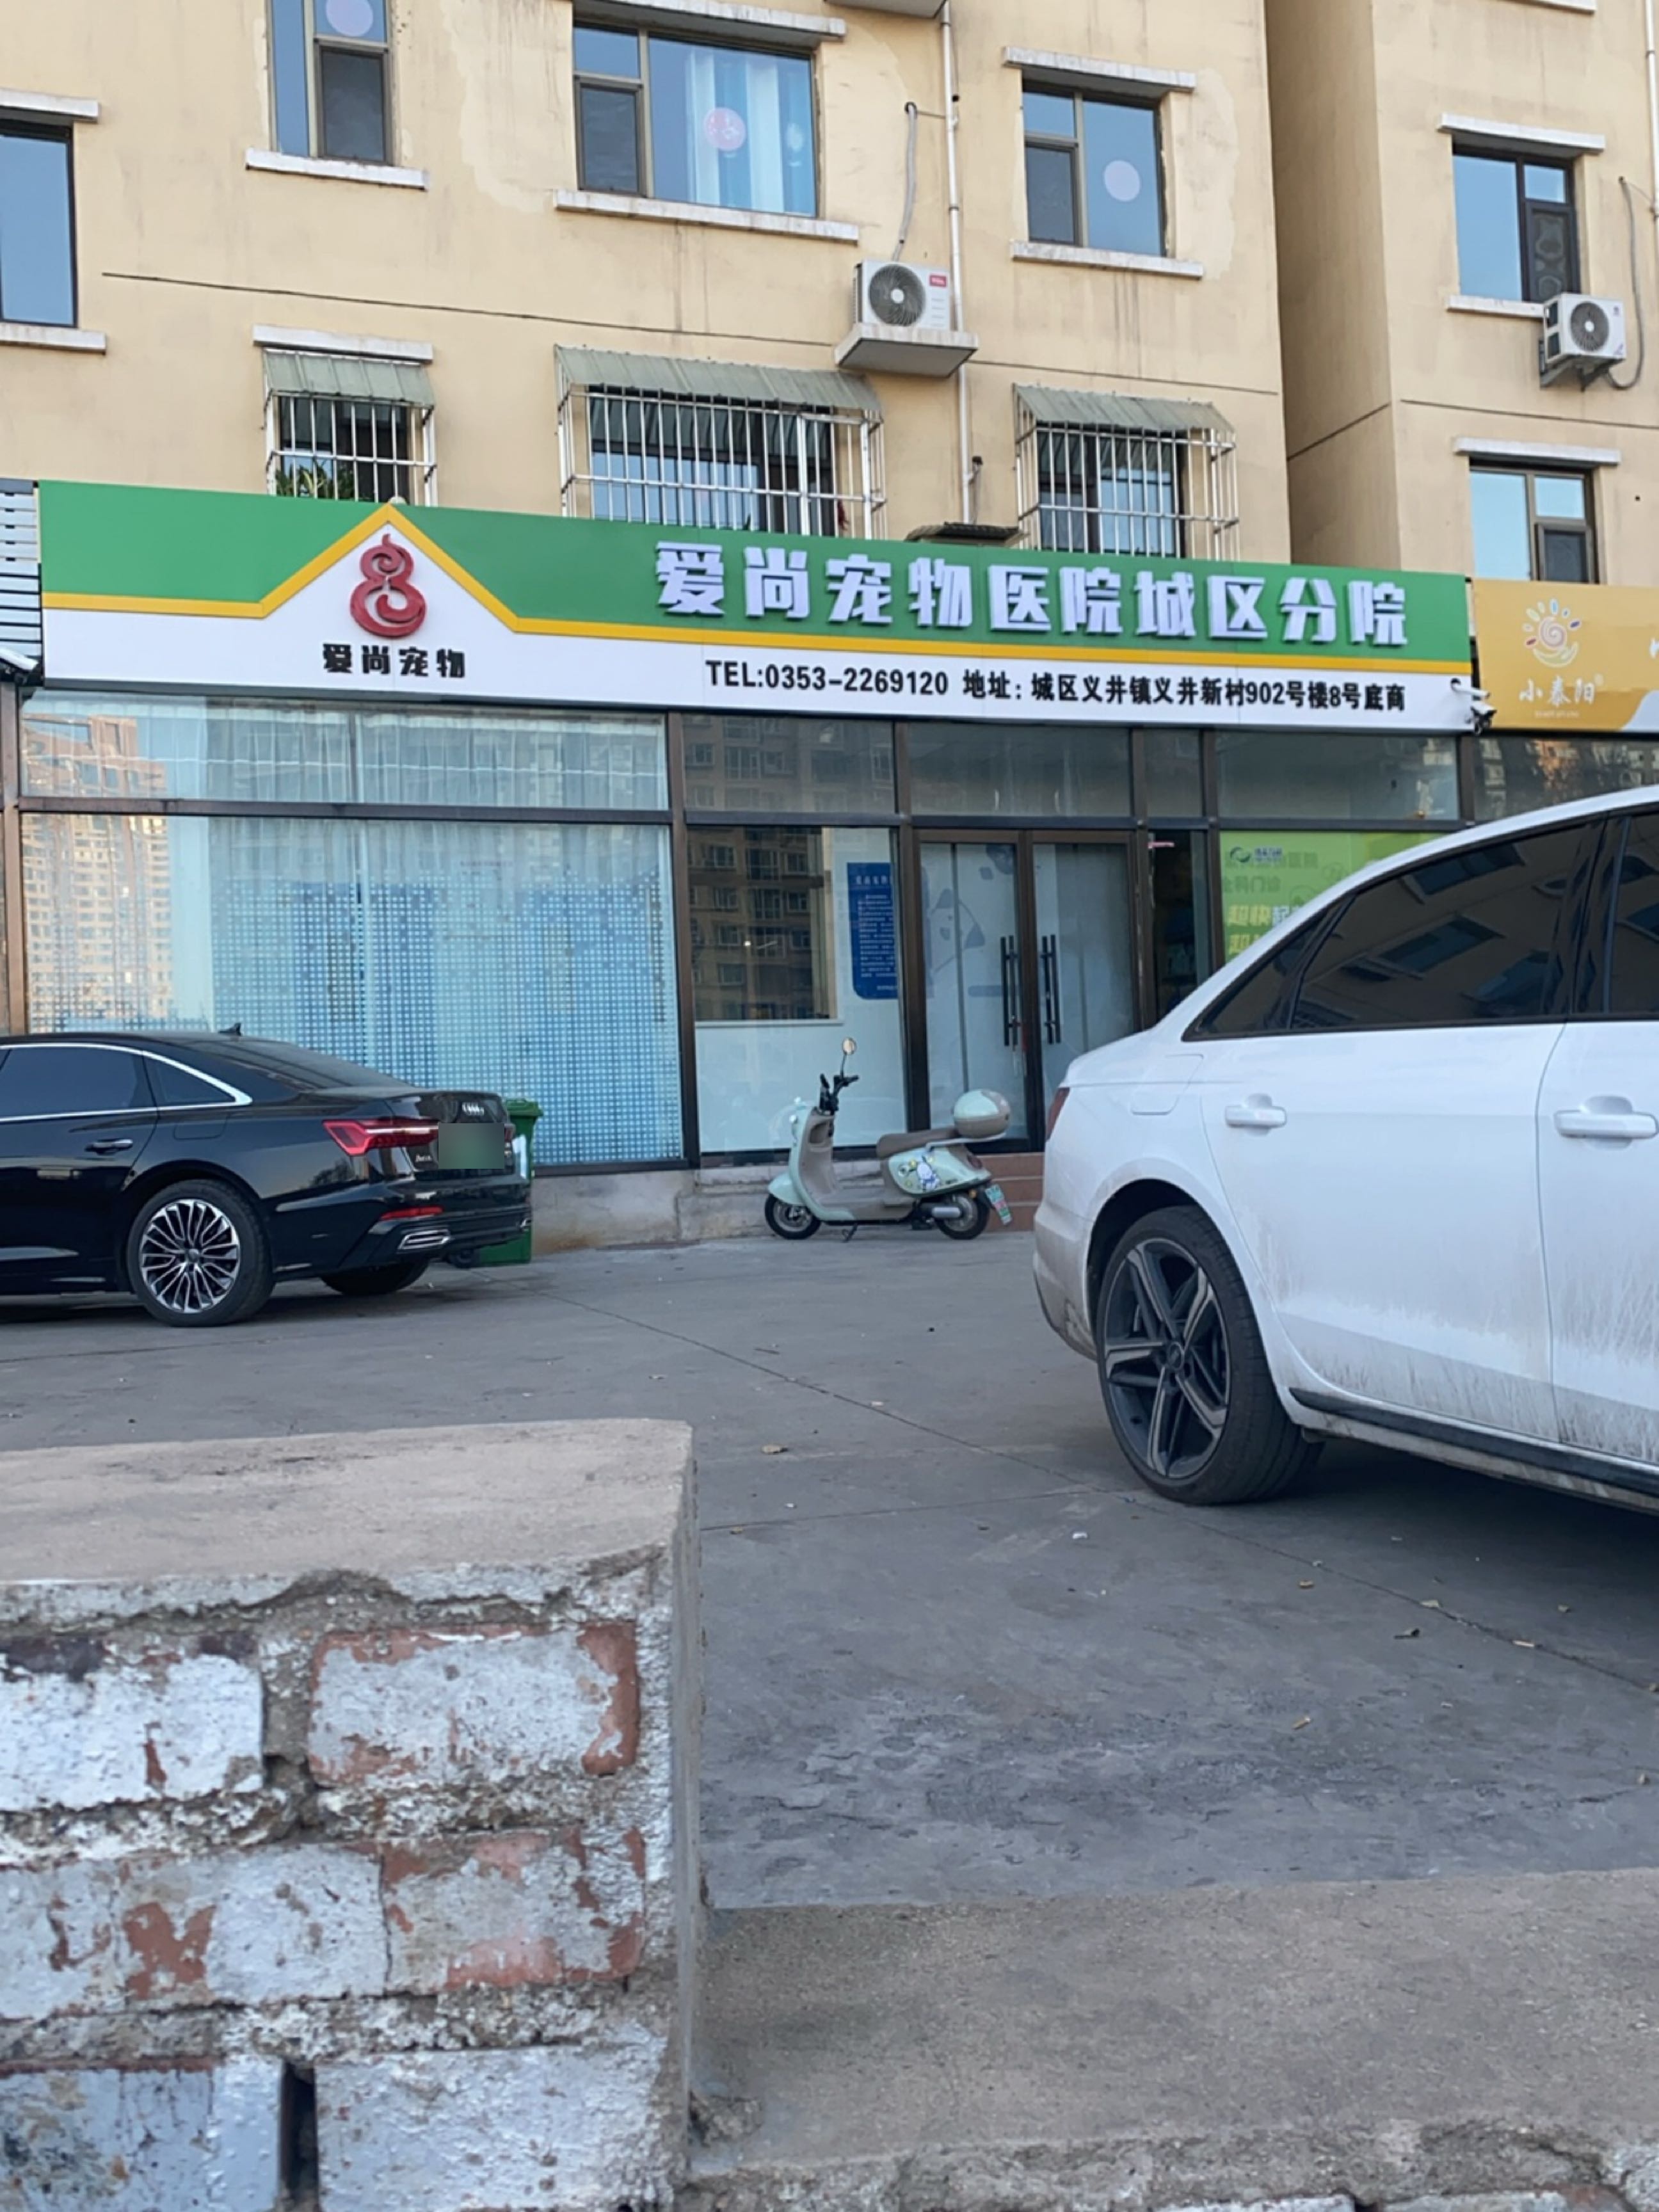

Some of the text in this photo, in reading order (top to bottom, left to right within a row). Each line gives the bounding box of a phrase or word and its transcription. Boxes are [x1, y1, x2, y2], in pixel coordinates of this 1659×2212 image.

[655, 541, 1408, 646] 爱尚宠物医院城区分院
[322, 643, 466, 678] 爱尚宠物
[705, 659, 949, 696] TEL:0353-2269120
